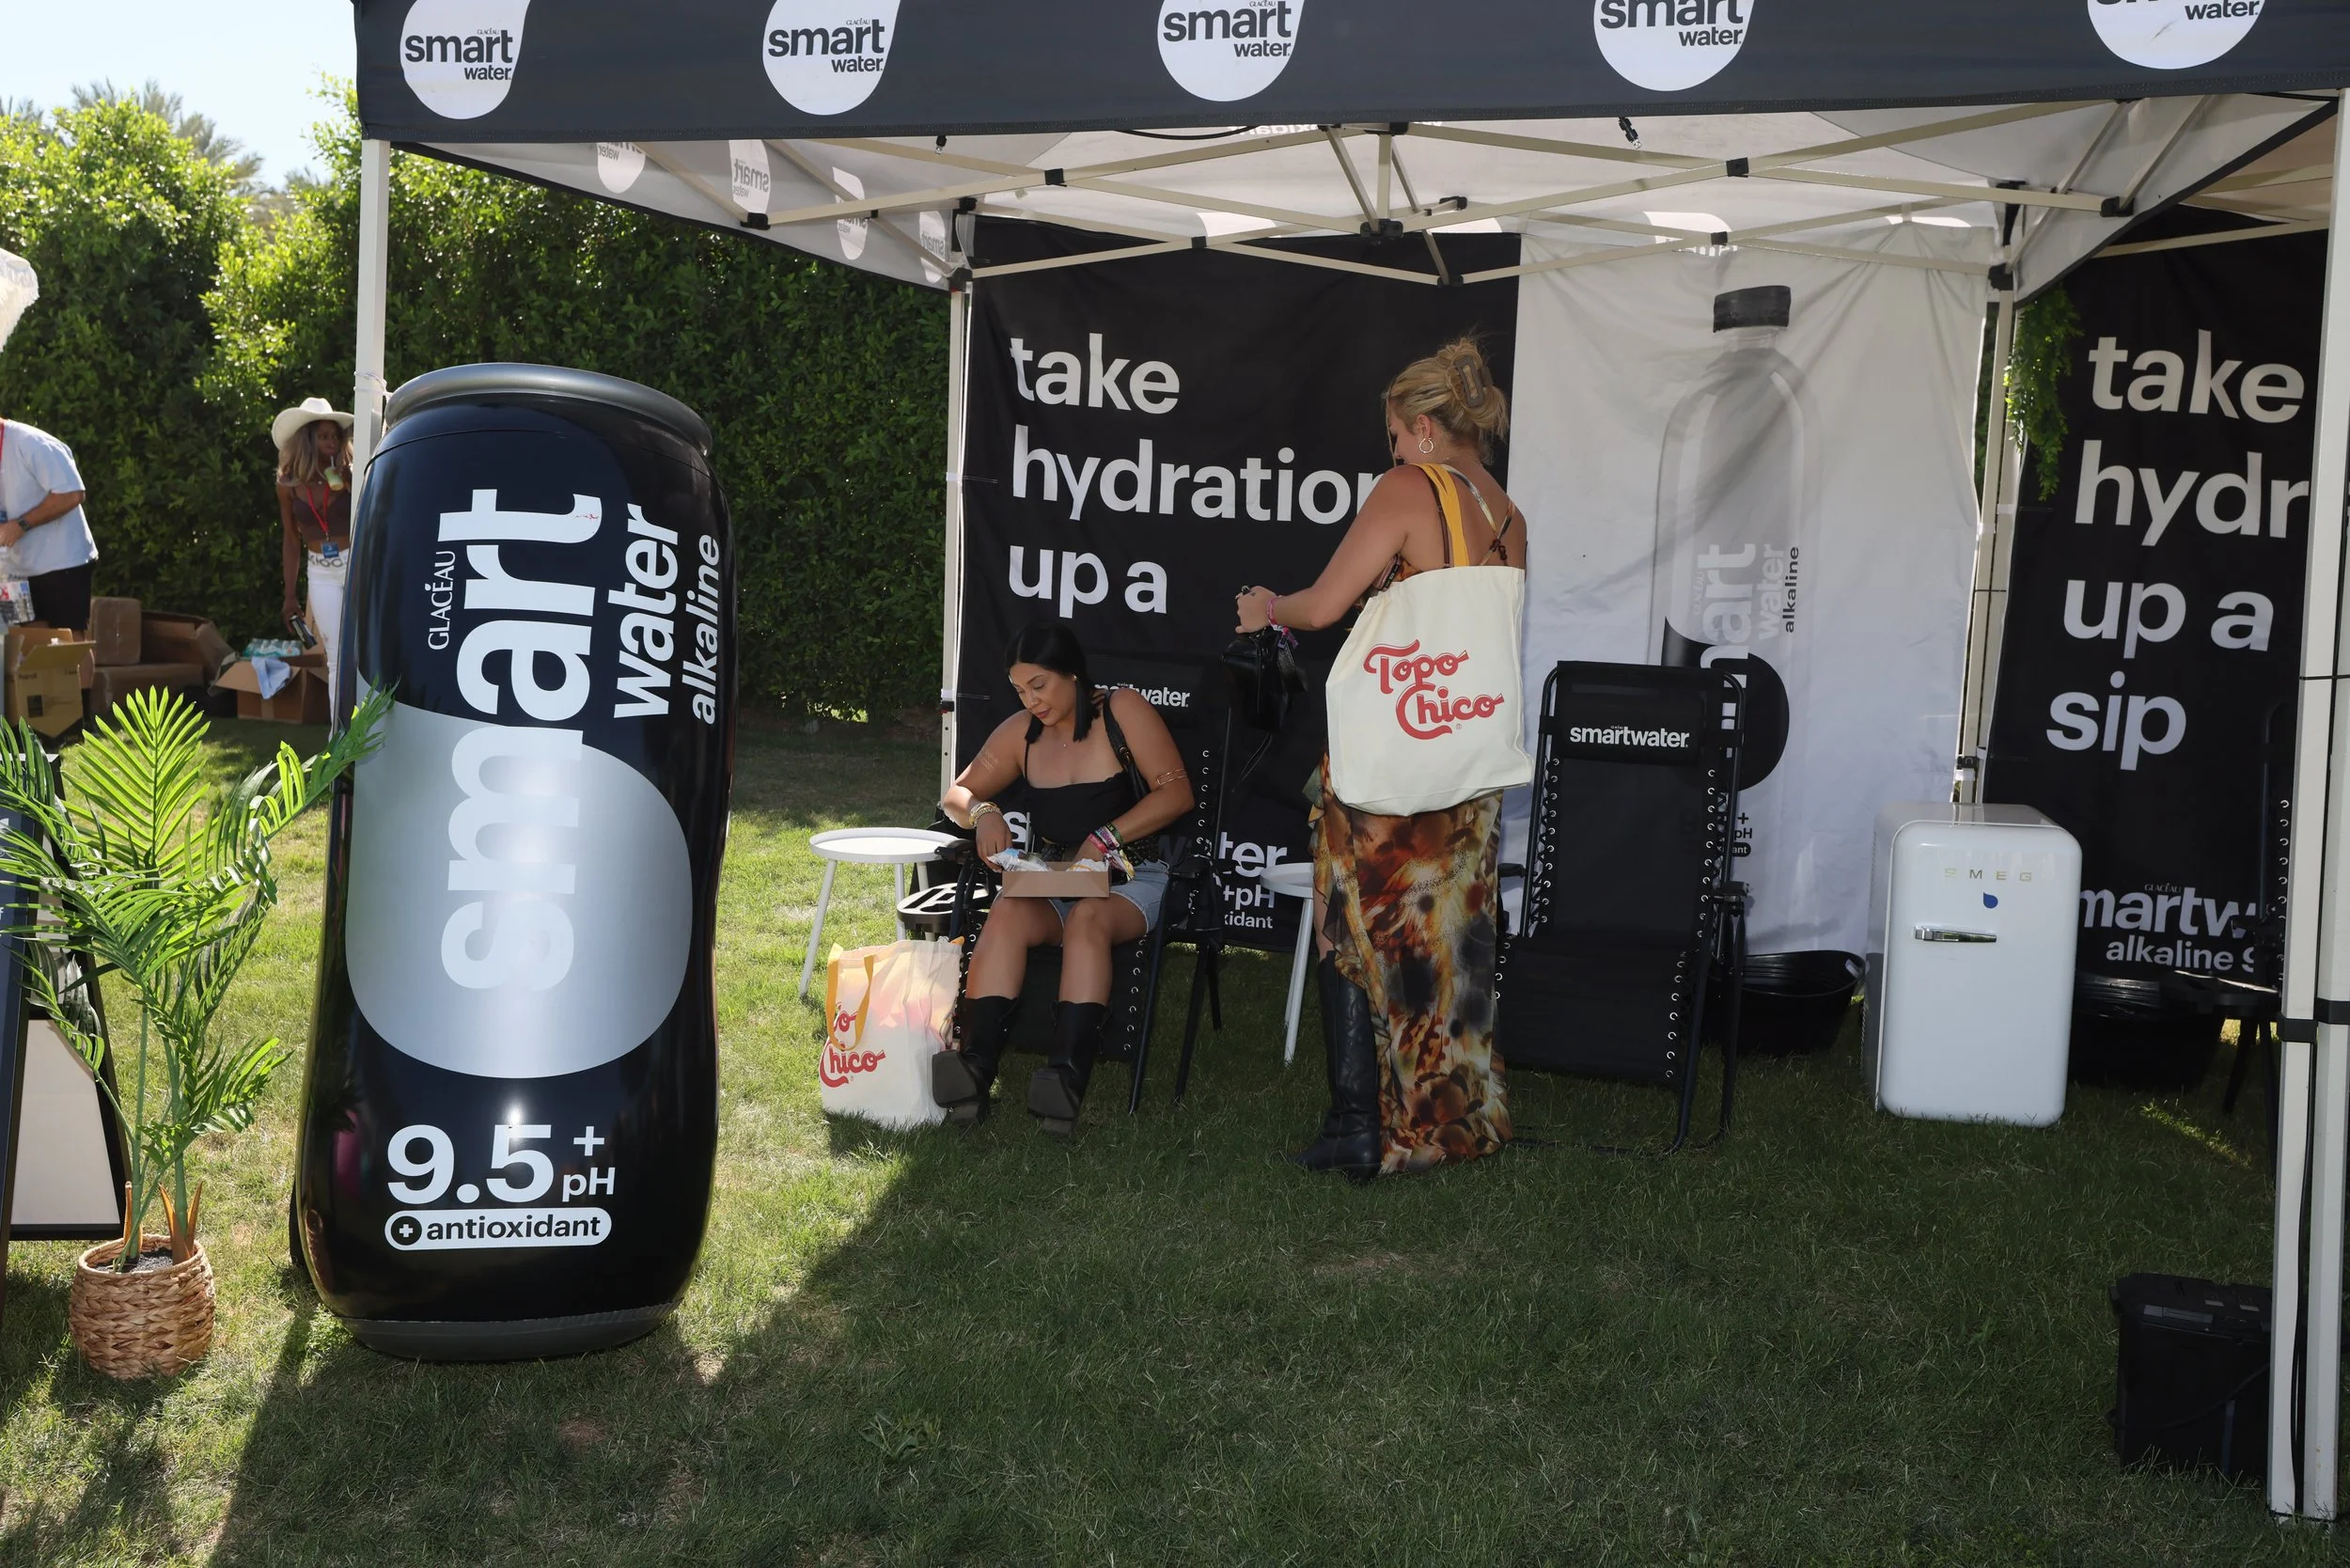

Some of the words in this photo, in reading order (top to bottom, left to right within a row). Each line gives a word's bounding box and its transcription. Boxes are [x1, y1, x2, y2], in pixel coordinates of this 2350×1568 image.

[1163, 1, 1292, 42] smart
[1678, 26, 1743, 46] water
[2185, 0, 2260, 20] water
[405, 29, 513, 63] smart
[768, 19, 885, 57] smart
[831, 55, 884, 72] water
[1233, 40, 1291, 57] water
[464, 65, 511, 81] water
[1010, 333, 1181, 415] take
[2088, 329, 2305, 424] take
[424, 550, 456, 651] GLACÉAU
[1009, 545, 1109, 619] up
[1124, 561, 1167, 614] a
[1755, 543, 1784, 640] water
[1782, 546, 1800, 634] alkaline
[607, 503, 679, 719] water
[682, 534, 720, 726] alkaline
[2062, 579, 2187, 659] up
[2210, 591, 2275, 651] a
[1363, 639, 1469, 694] Topo
[1396, 682, 1505, 740] Chico
[1569, 726, 1690, 748] smartwater
[2045, 670, 2187, 771] sip
[437, 488, 603, 993] smart
[1944, 867, 2032, 882] SMEG
[2106, 933, 2234, 971] alkaline
[820, 1039, 886, 1088] Chico
[387, 1123, 555, 1204] 9.5
[561, 1167, 616, 1202] pH
[426, 1214, 602, 1241] antioxidant
